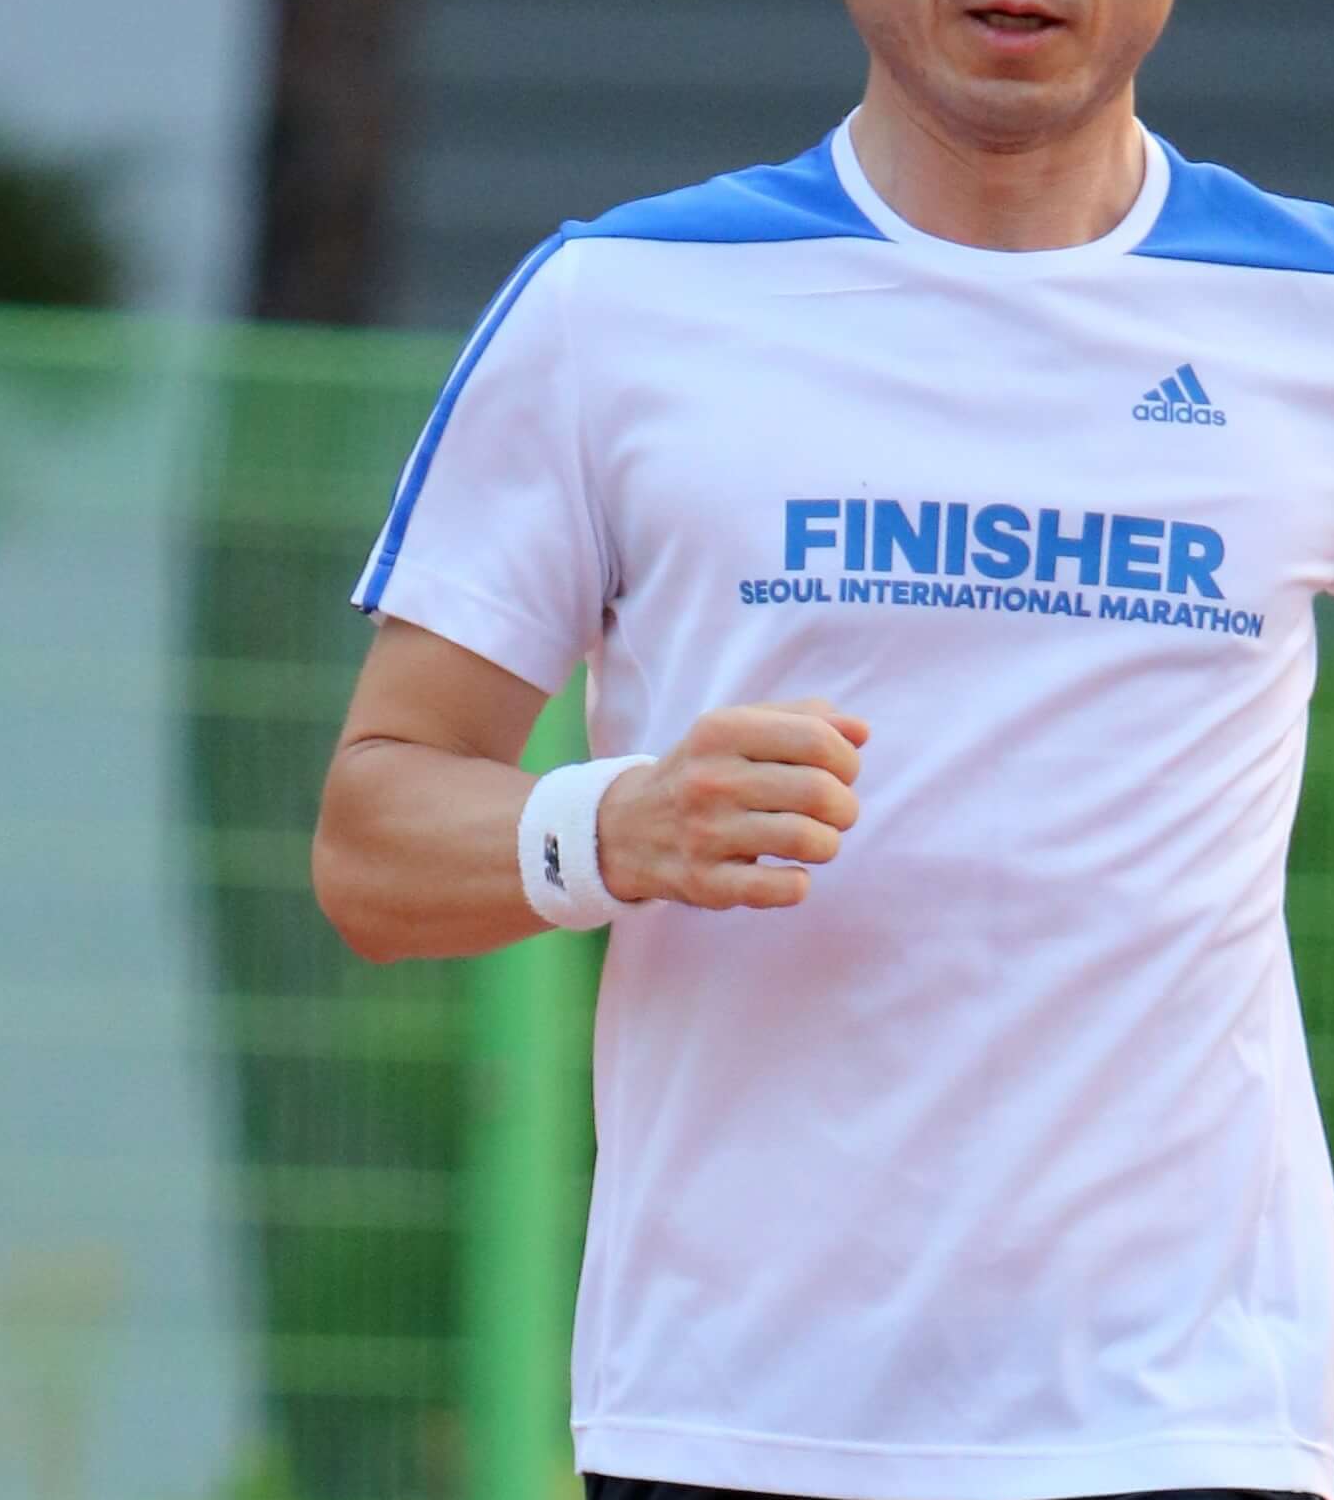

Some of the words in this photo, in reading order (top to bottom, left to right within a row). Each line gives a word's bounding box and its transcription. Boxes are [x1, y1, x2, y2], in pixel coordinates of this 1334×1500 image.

[1132, 399, 1227, 426] adidas
[784, 498, 1225, 600] FINISHER
[739, 578, 832, 606] SEOUL
[838, 578, 1092, 618] INTERNATIONAL
[1098, 594, 1265, 638] MARATHON
